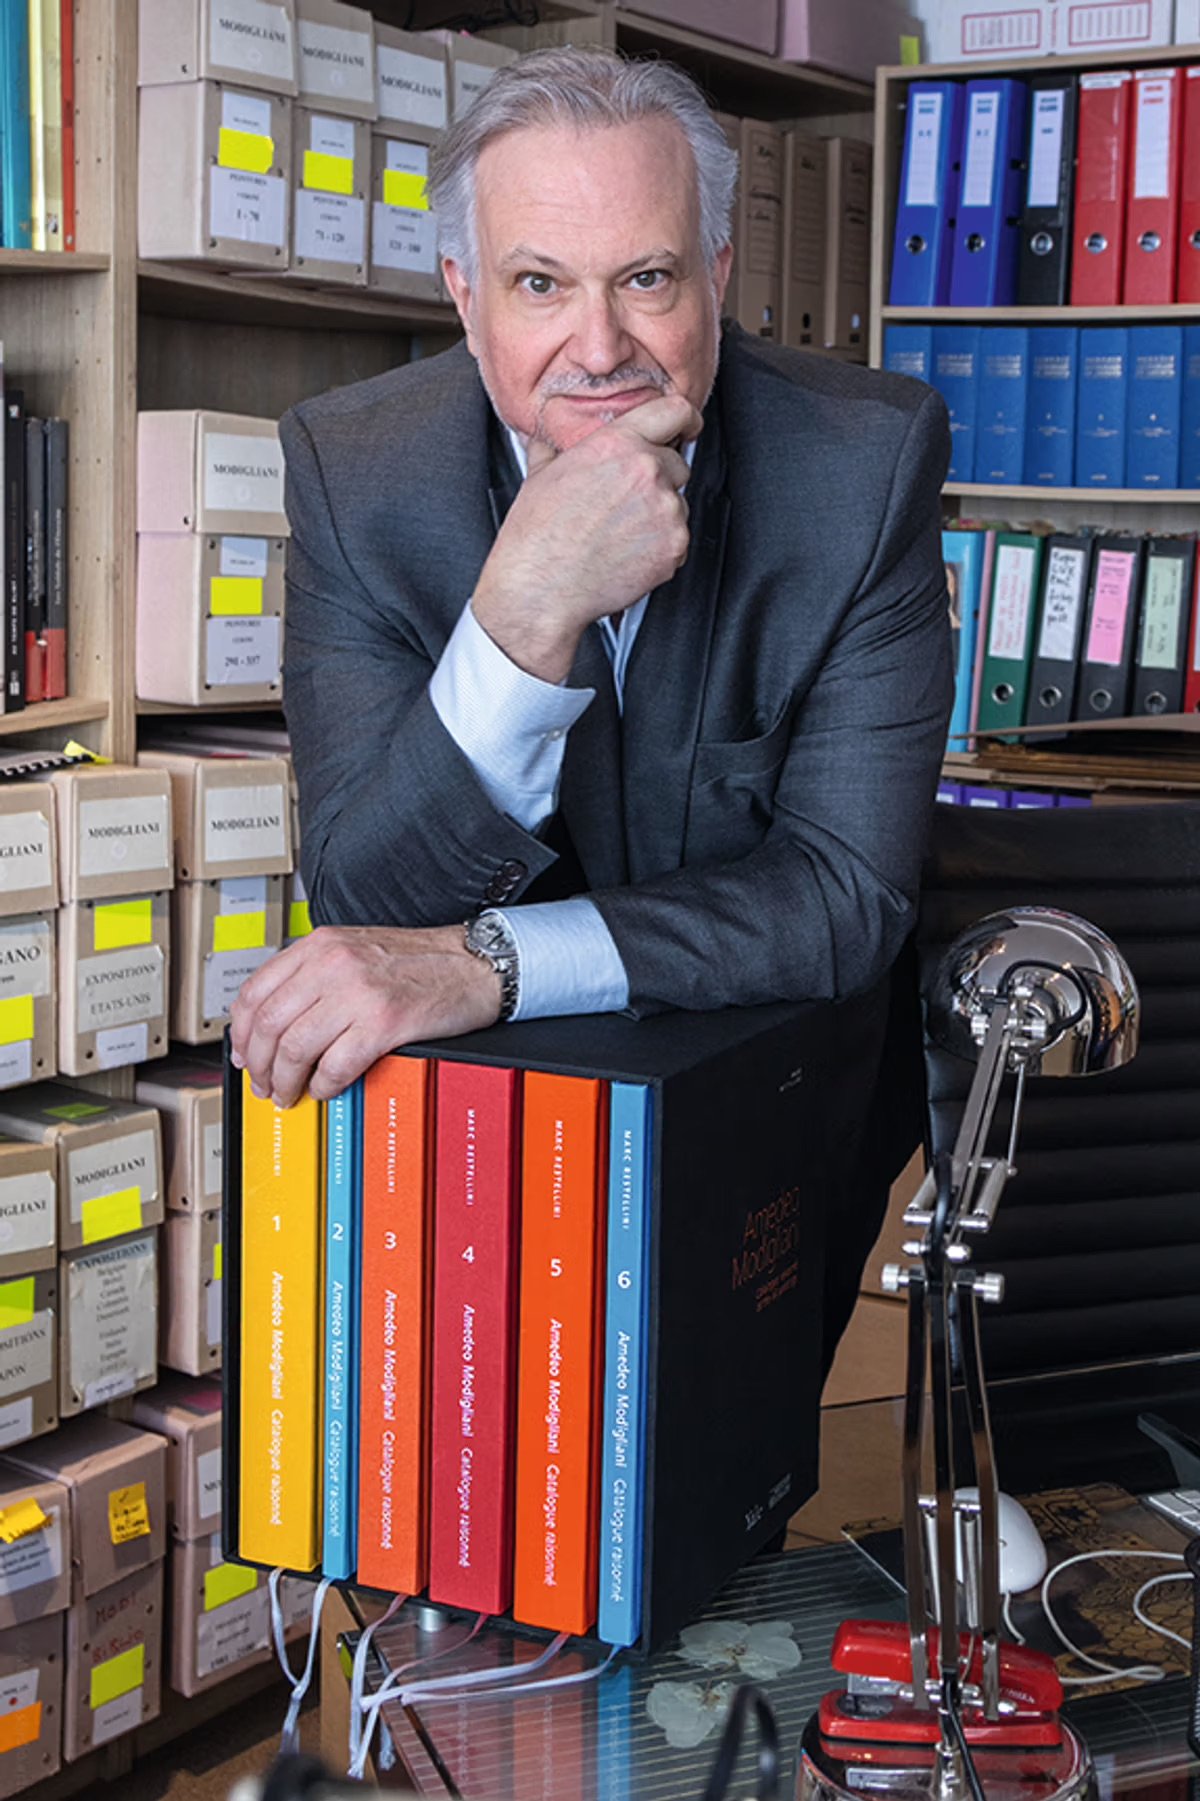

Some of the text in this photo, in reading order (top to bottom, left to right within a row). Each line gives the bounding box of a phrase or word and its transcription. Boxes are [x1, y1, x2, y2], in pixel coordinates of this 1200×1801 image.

[218, 17, 287, 44] MODIGLIANI
[301, 46, 365, 67] MODIGLIANI
[381, 74, 442, 98] MODIGLIANI
[213, 463, 280, 479] MODIGLIANI
[88, 822, 160, 839] MODIGLIANI
[210, 815, 281, 833] MODIGLIANI
[86, 964, 156, 987] EXPOSITIONS
[334, 1125, 344, 1185] RESTELLINI
[388, 1133, 396, 1193] RESTELLINI
[466, 1109, 475, 1205] MARC RESTELLINI
[74, 1155, 146, 1187] MODIGLIANI
[553, 1120, 563, 1218] MARC RESTELLINI
[622, 1130, 632, 1229] MARC RESTELLINI
[271, 1215, 281, 1232] 1
[332, 1222, 344, 1241] 2
[385, 1231, 397, 1250] 3
[462, 1245, 475, 1264] 4
[550, 1258, 563, 1277] 5
[617, 1270, 632, 1289] 6
[268, 1271, 284, 1526] Amedeo Modigliani Catalogue raisonné
[327, 1281, 344, 1537] Amedeo Modigliani Catalogue raisonné
[379, 1289, 398, 1550] Amedeo Modigliani Catalogue raisonné
[457, 1304, 476, 1568] Amedeo Modigliani Catalogue raisonné
[543, 1318, 563, 1587] Amedeo Modigliani Catalogue raisonné
[609, 1331, 631, 1603] Amedeo Modigliani Catalogue raisonné
